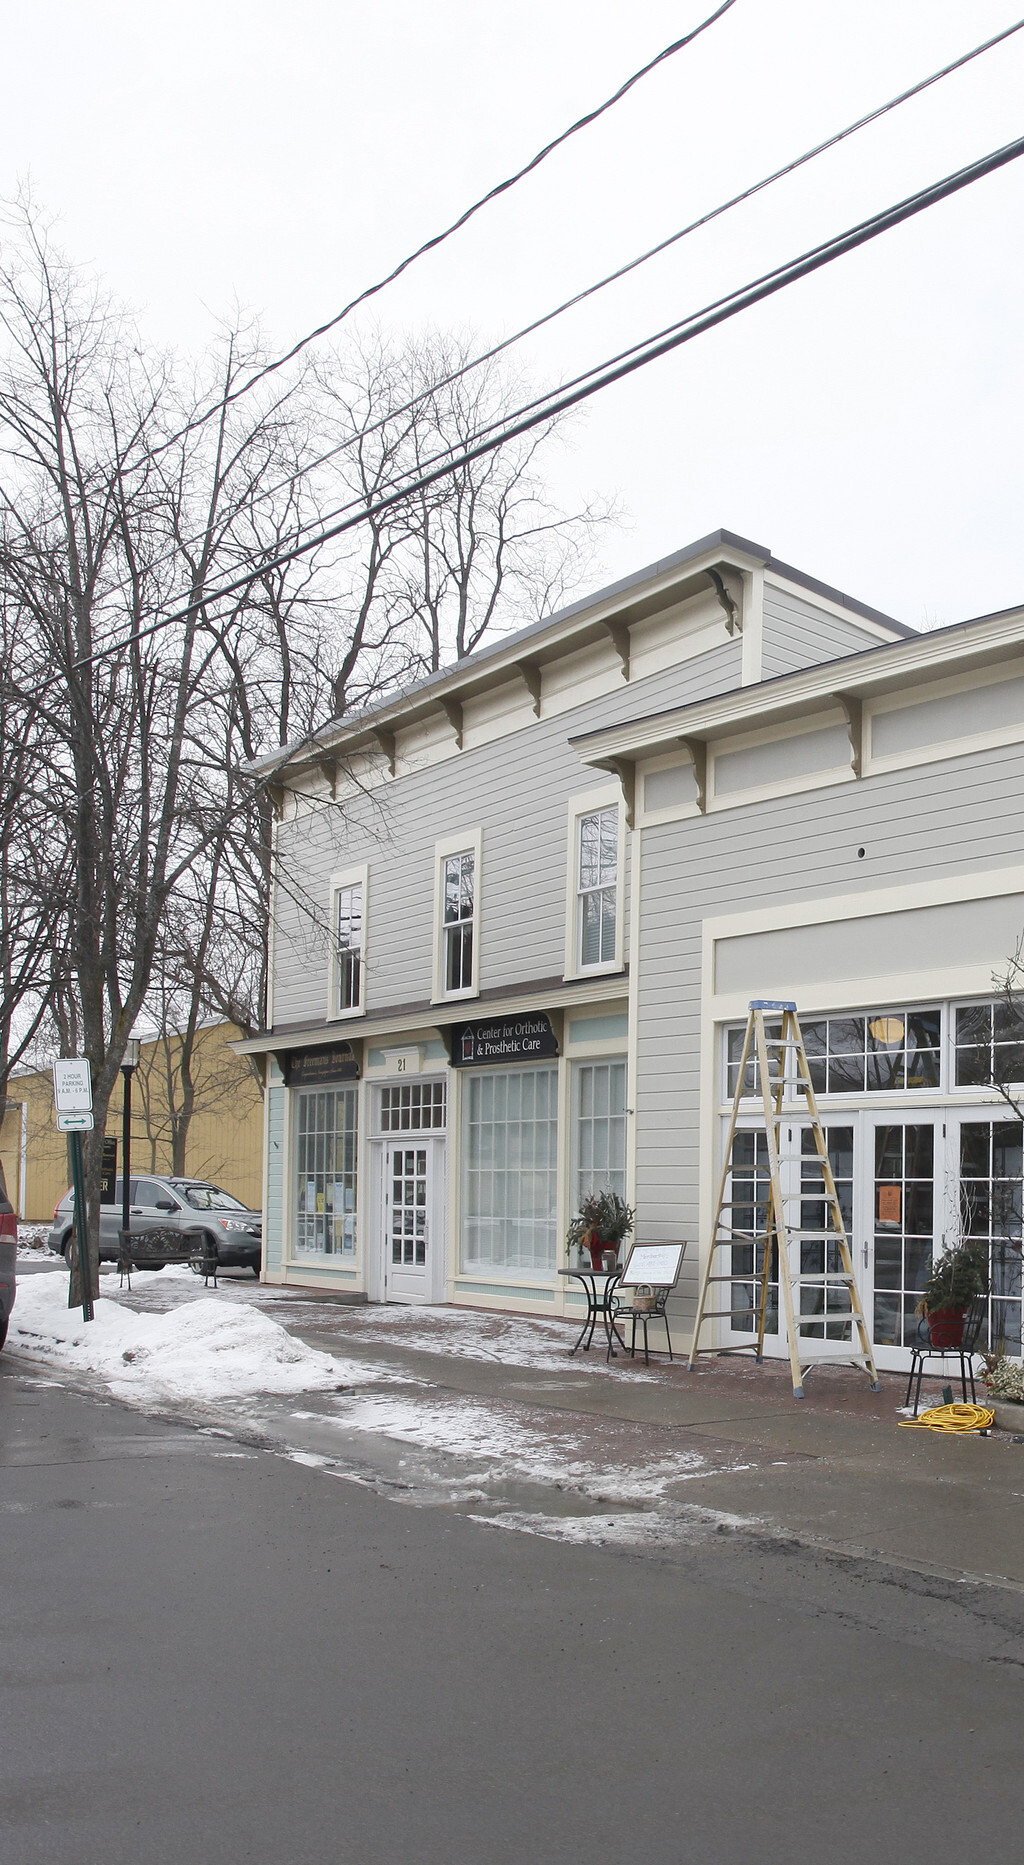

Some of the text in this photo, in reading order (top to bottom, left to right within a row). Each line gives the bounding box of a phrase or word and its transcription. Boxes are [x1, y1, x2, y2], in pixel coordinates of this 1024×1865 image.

[476, 1027, 501, 1040] Center
[502, 1023, 513, 1037] for
[515, 1020, 548, 1035] Orthotic
[476, 1037, 541, 1056] & Prosthetic Care
[397, 1058, 406, 1071] 21
